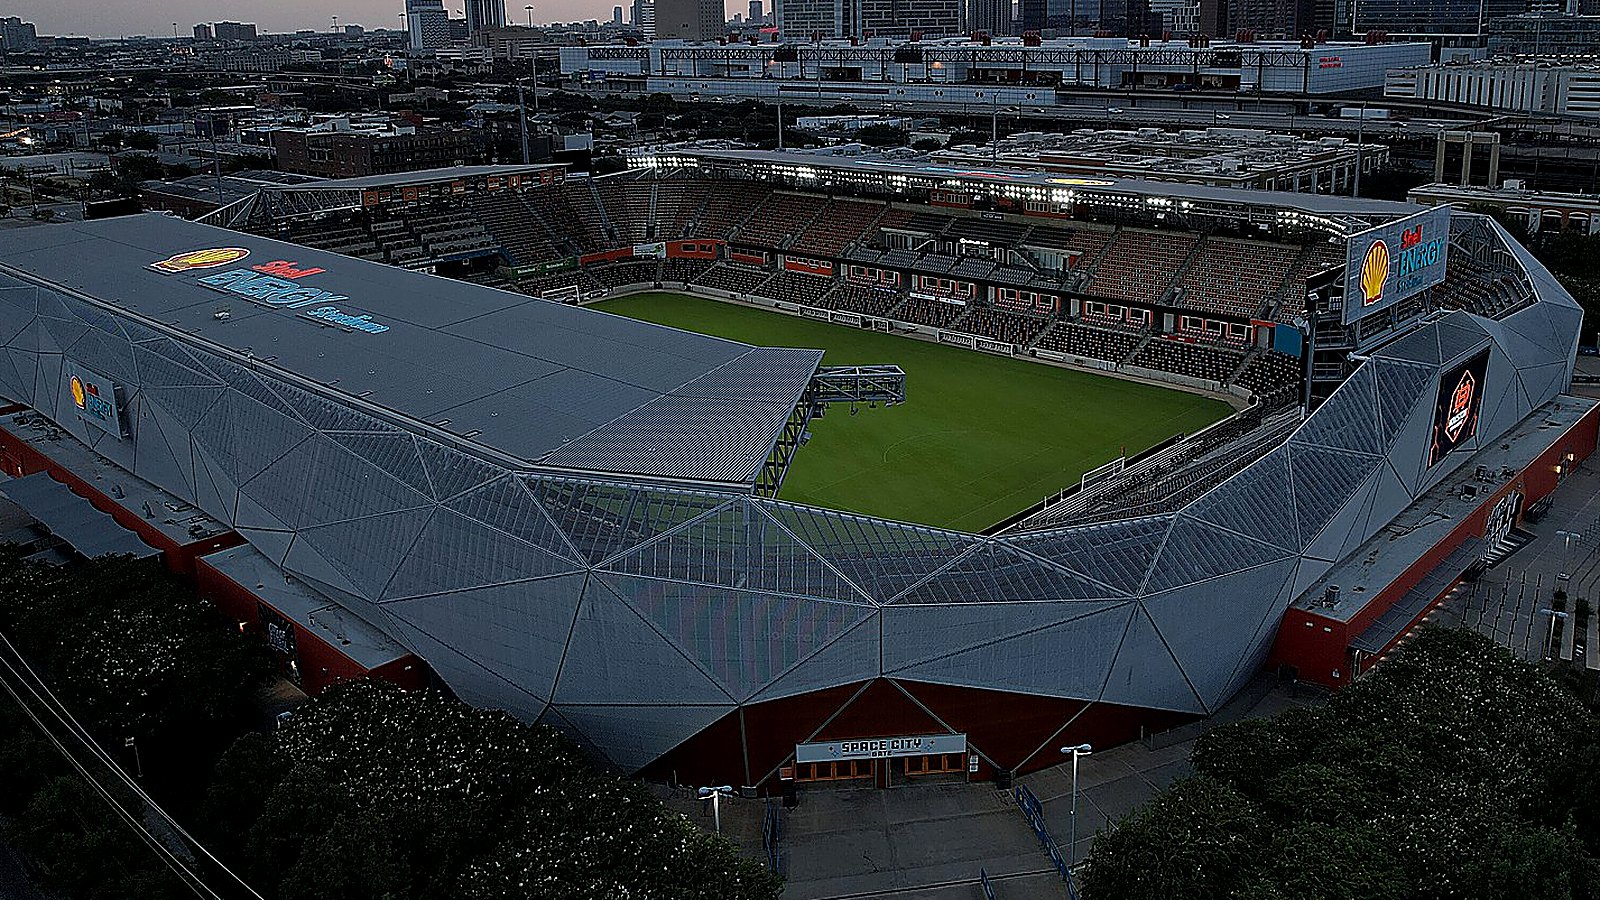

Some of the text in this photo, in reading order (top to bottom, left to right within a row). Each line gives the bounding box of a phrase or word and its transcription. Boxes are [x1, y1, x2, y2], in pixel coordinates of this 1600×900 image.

[1398, 237, 1444, 278] ENERGY
[197, 268, 349, 309] ENERGY
[842, 738, 922, 753] SPACE CITY
[871, 750, 893, 758] GATE
